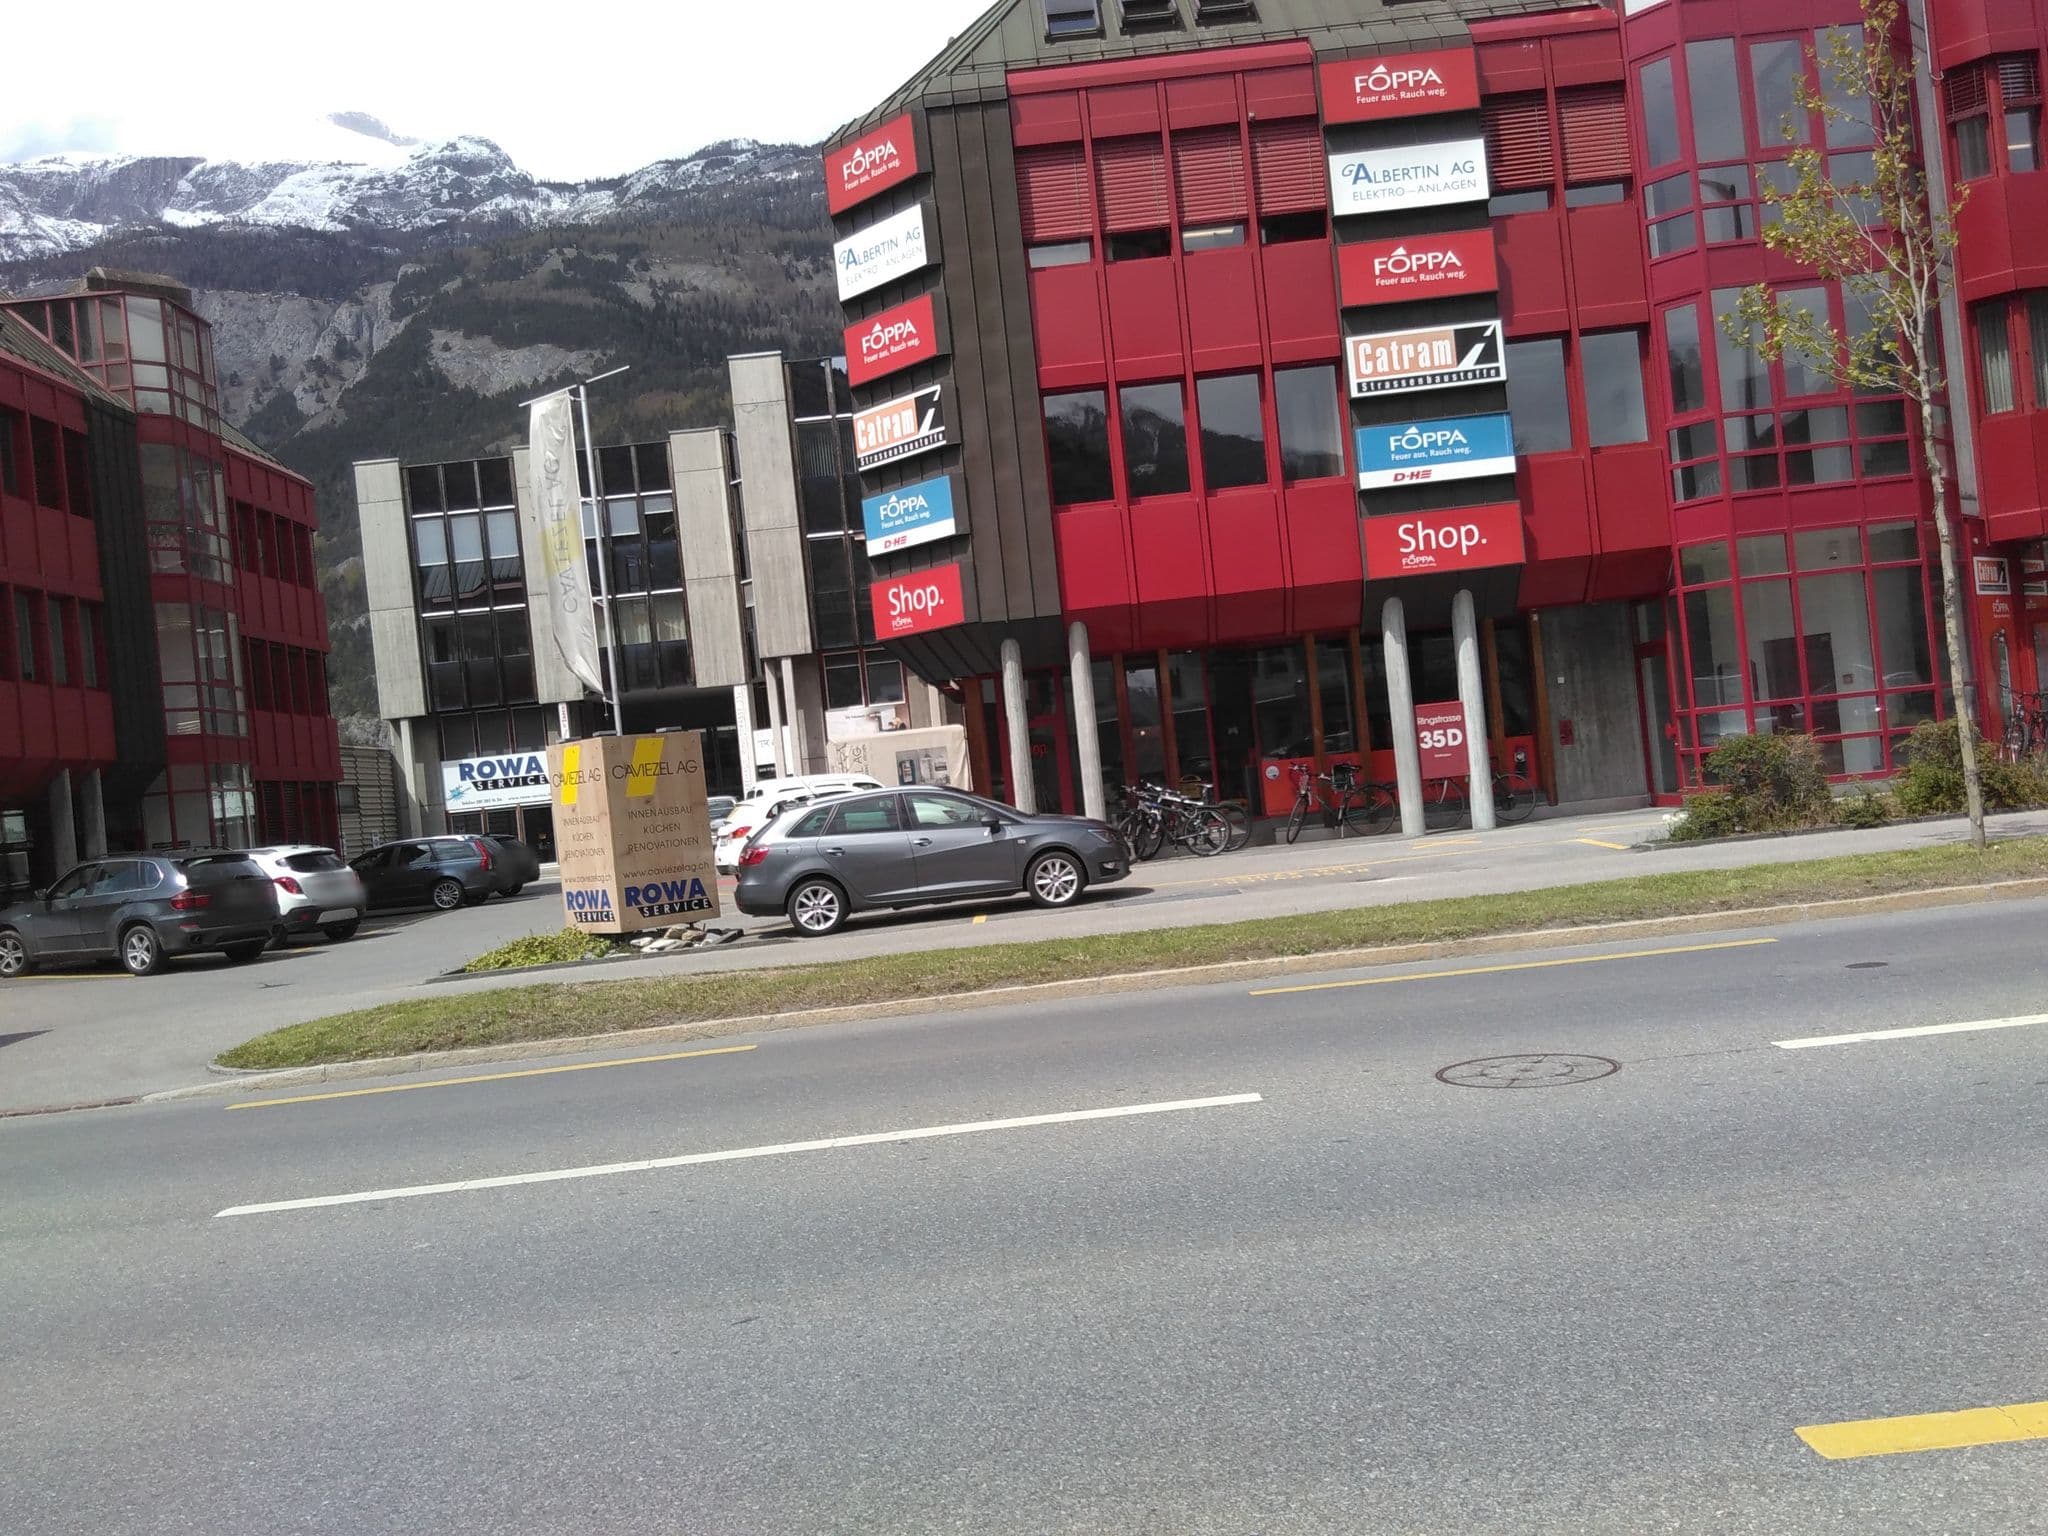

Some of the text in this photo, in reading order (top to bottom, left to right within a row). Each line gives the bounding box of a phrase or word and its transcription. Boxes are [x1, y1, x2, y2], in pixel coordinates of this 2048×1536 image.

[1356, 95, 1379, 104] Feuer
[1400, 88, 1425, 100] Rauch
[1427, 87, 1448, 97] weg.
[1451, 160, 1475, 175] AG
[906, 226, 920, 244] AG
[1375, 277, 1399, 286] Feuer
[1419, 271, 1445, 282] Rauch
[1359, 338, 1453, 375] Catram
[1362, 368, 1497, 392] Strassenbaustoffe
[857, 408, 915, 450] Catram
[1391, 452, 1412, 461] Feuer
[1430, 447, 1453, 457] Rauch
[1417, 714, 1462, 726] Ringstrasse
[459, 755, 544, 781] ROWA
[612, 760, 698, 779] CAVIEZEL AG
[477, 775, 546, 790] SERVICE
[628, 806, 692, 820] INNENAUSBAU
[643, 823, 681, 834] KÜCHEN
[628, 837, 699, 853] RENOVATIONEN
[566, 889, 611, 911] ROWA
[624, 878, 707, 907] ROWA
[576, 911, 614, 922] SERVICE
[643, 899, 710, 917] SERVICE
